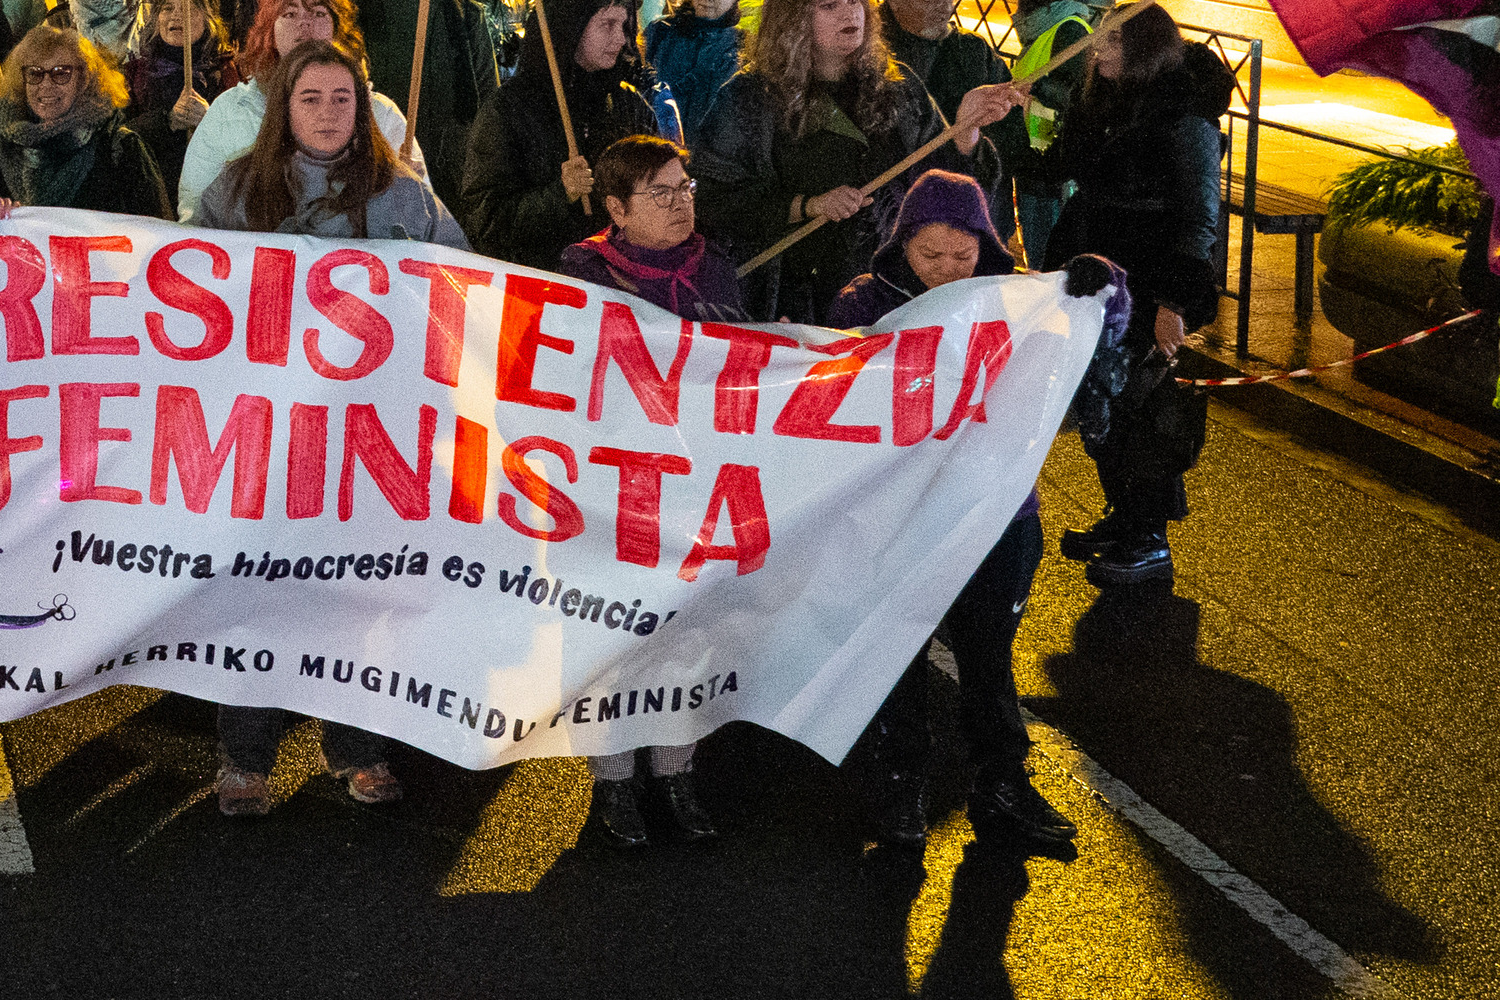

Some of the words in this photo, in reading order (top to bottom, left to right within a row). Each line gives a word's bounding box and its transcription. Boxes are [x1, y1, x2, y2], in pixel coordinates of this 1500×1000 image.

[52, 530, 216, 580] ¡Vuestra
[231, 544, 429, 582] hipocresía
[442, 555, 486, 589] es
[93, 641, 276, 678] HERRIKO
[299, 653, 537, 743] MUGIMENDU
